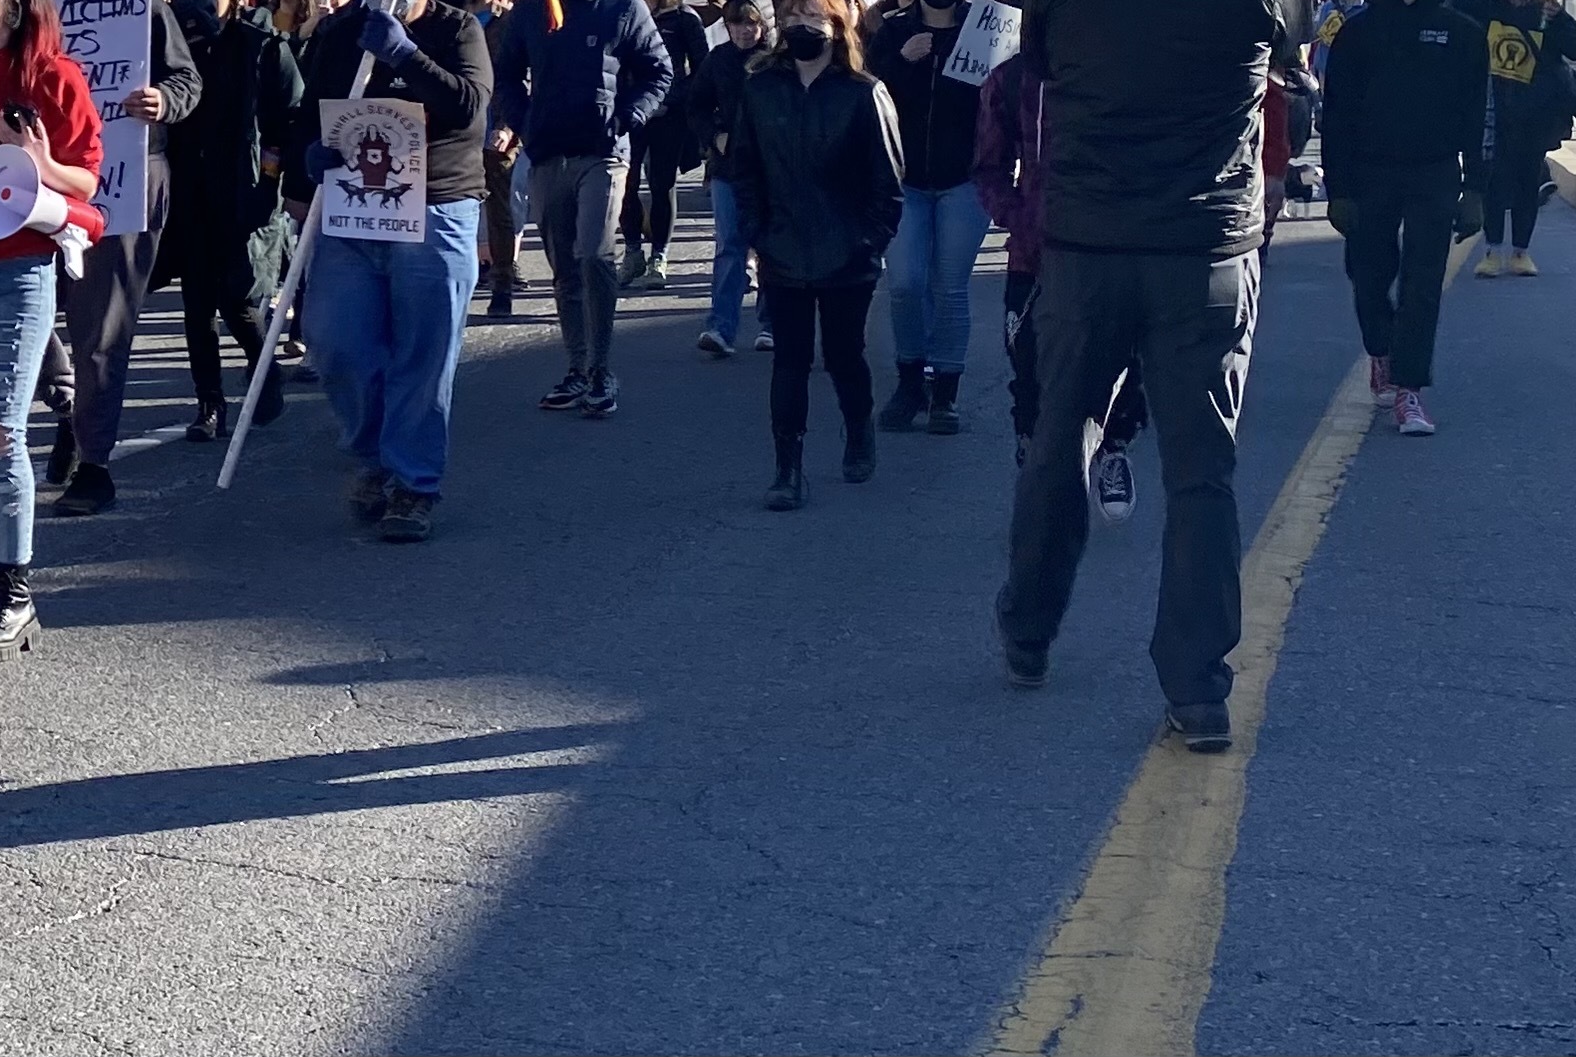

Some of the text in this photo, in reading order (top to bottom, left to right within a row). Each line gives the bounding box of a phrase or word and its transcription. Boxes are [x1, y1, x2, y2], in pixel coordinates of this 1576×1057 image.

[65, 29, 101, 56] IS
[367, 104, 415, 131] SERVES
[408, 131, 422, 174] POLICE
[329, 215, 420, 233] NOT THE PEOPLE
